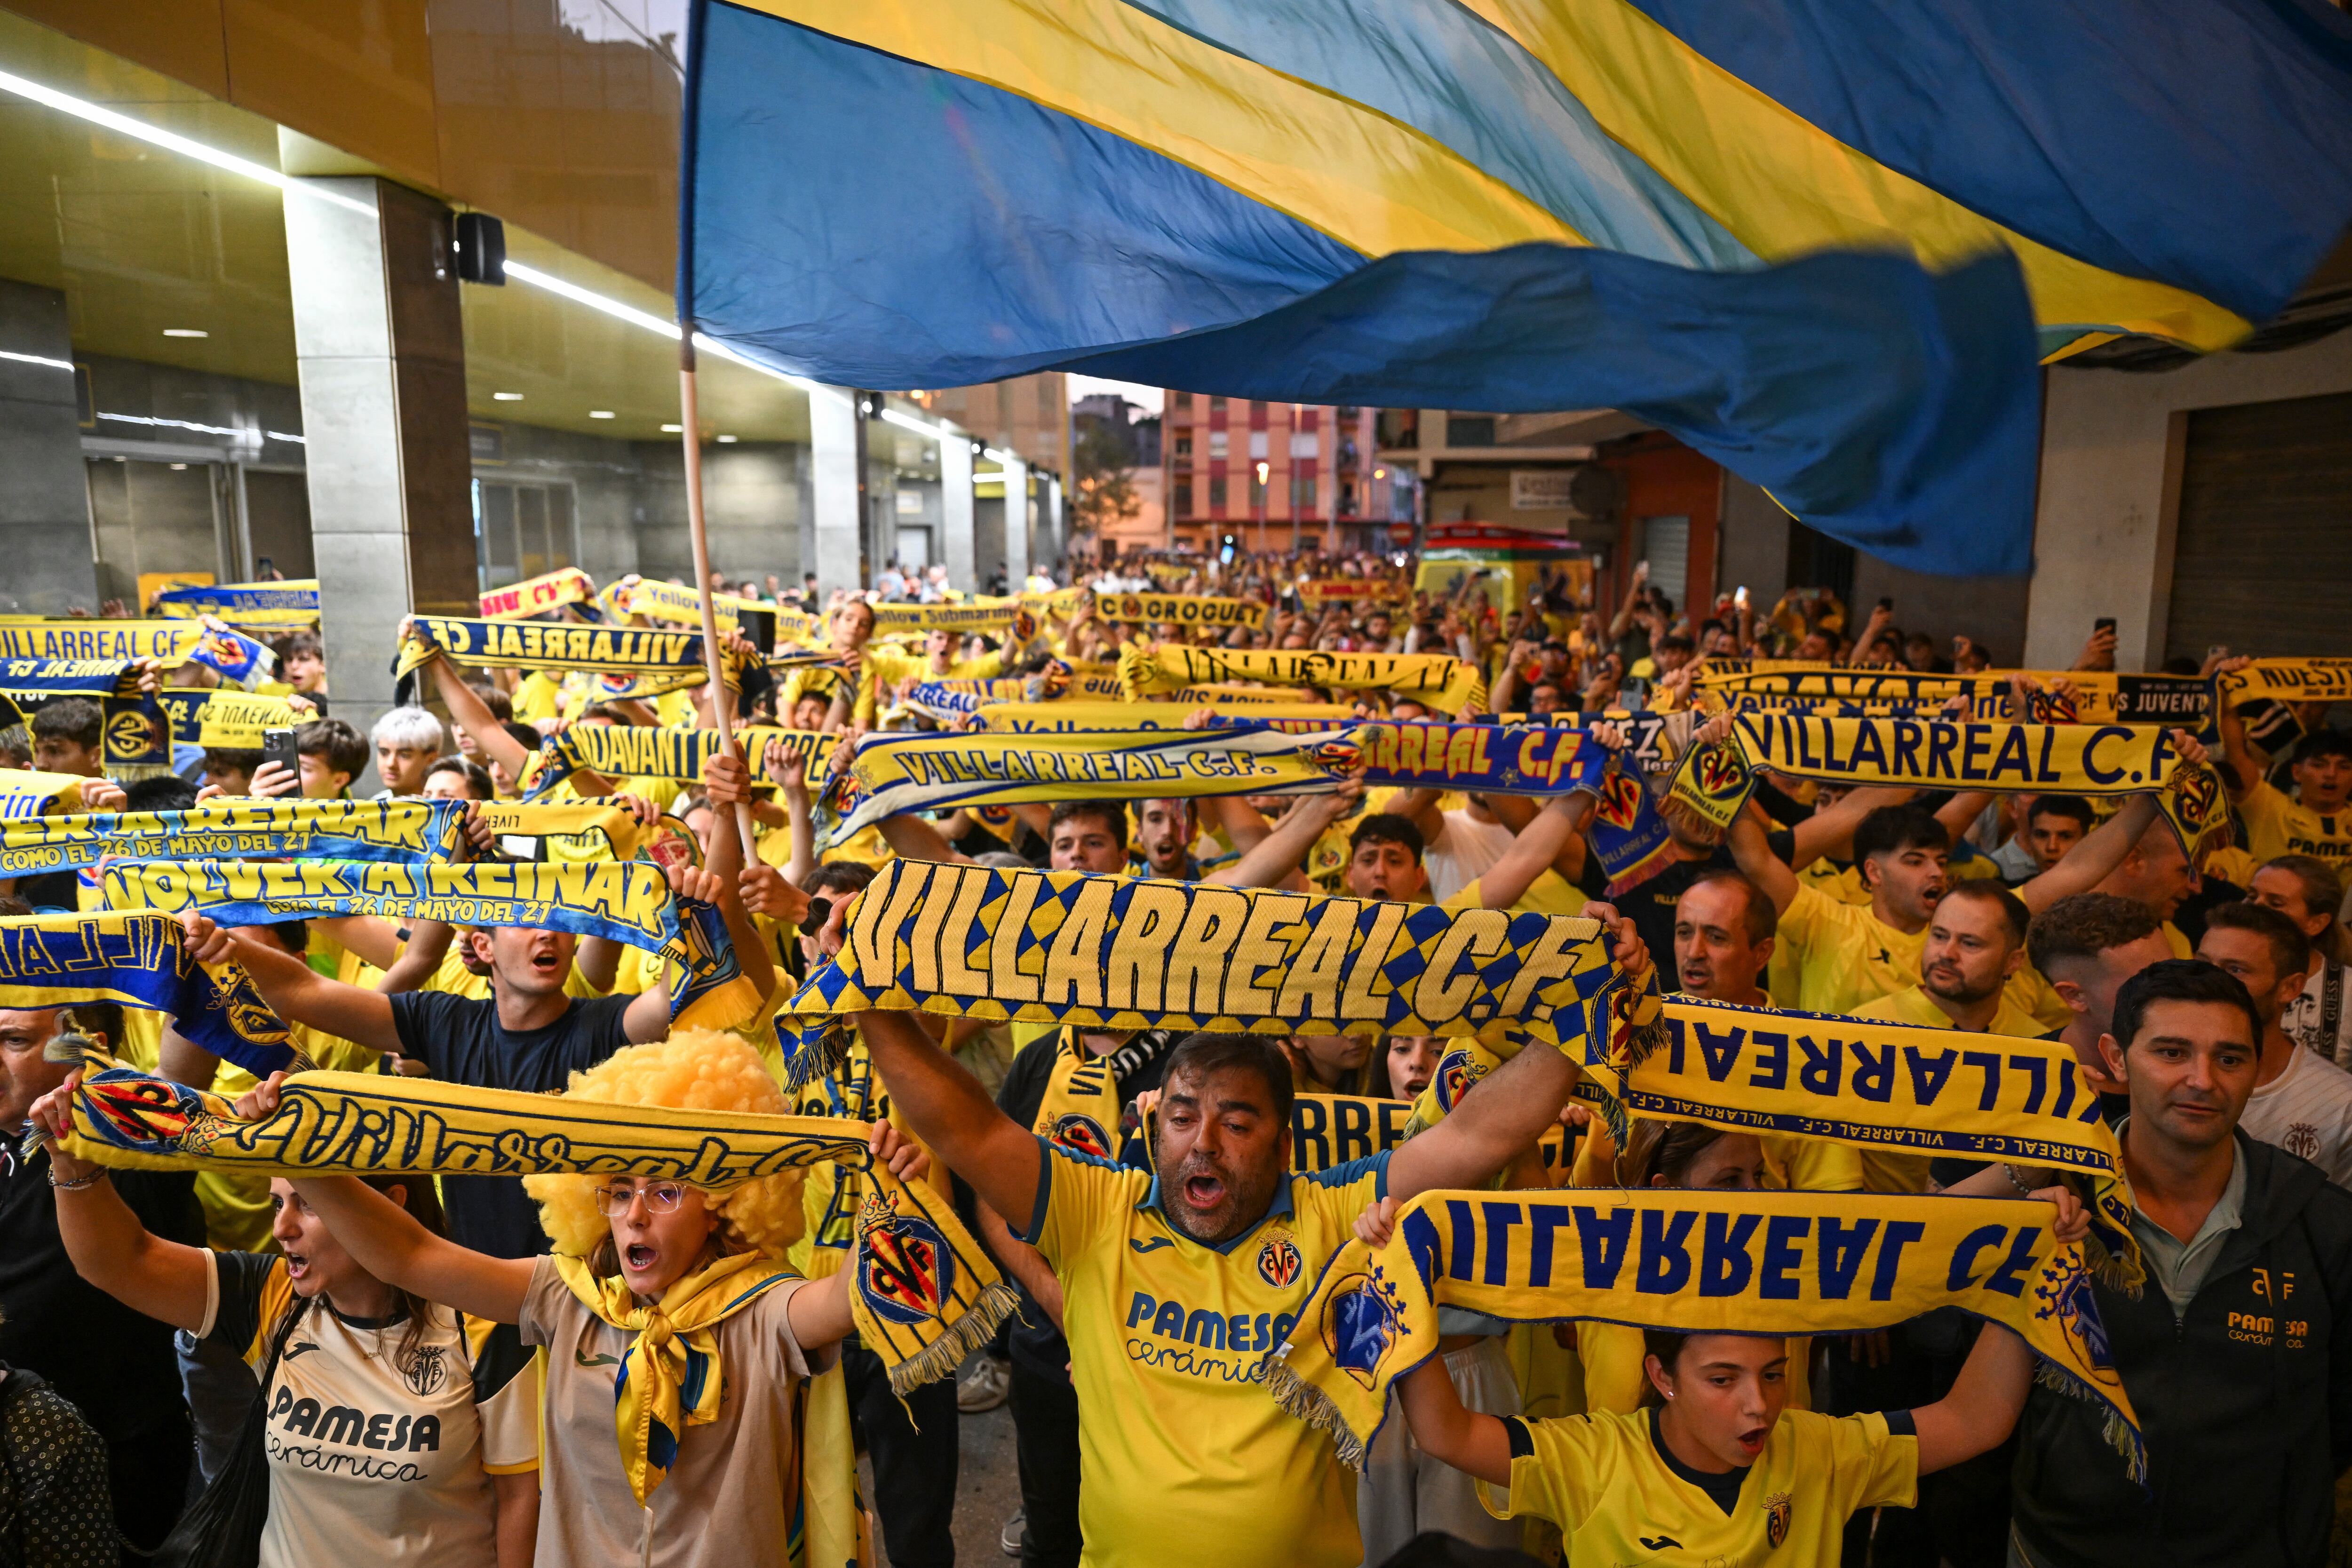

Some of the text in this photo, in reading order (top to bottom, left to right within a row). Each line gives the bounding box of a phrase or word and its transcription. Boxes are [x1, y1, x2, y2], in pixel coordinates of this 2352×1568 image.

[0, 629, 184, 658] ILLARREAL CF
[893, 750, 1182, 786] VILLARREAL
[1518, 730, 1585, 786] C.F.
[1737, 712, 2061, 782] VILLARREAL
[1, 847, 62, 872] COMO
[65, 845, 95, 864] EL
[97, 838, 131, 859] 26
[135, 837, 164, 857] DE
[167, 835, 234, 856] MAYO
[237, 833, 278, 852] DEL
[104, 861, 672, 939] VOLVER A REINAR
[348, 897, 378, 915] 26
[382, 899, 411, 917] DE
[413, 899, 476, 923] MAYO
[479, 899, 517, 923] DEL
[850, 858, 1603, 1024] VILLARREAL C.F.
[2325, 979, 2339, 1021] GUESS
[1632, 1092, 1774, 1127] VILLARREAL C.F.
[1799, 1118, 1944, 1146] VILLARREAL C.F.
[1970, 1136, 2114, 1167] ILLARREAL C.F.
[1126, 1291, 1295, 1352] PAMESA
[2228, 1311, 2308, 1337] PAMSA
[1126, 1338, 1265, 1383] cerámic
[267, 1385, 440, 1452] PAMESA
[266, 1431, 428, 1483] cerámica
